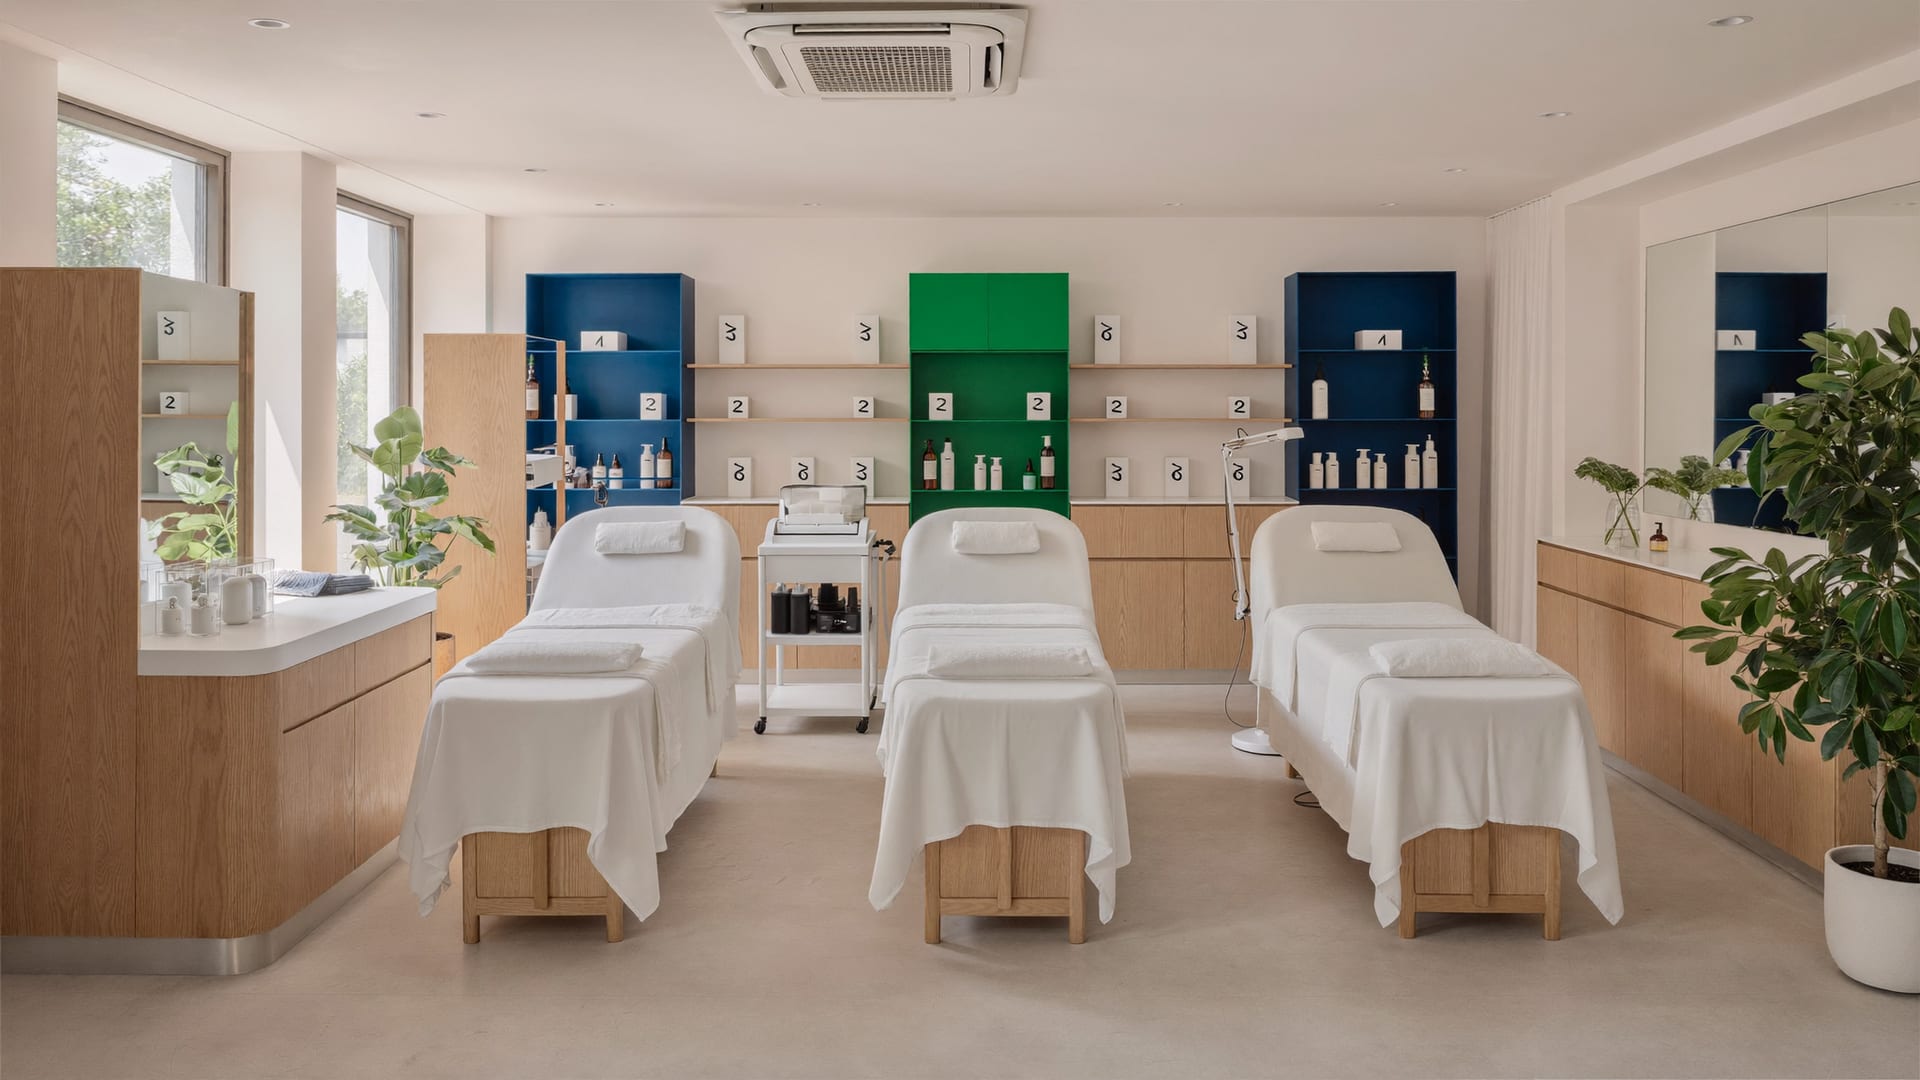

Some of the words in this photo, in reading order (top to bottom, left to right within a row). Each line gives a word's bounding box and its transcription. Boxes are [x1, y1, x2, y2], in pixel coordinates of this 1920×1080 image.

[165, 395, 176, 410] 2
[645, 397, 657, 411] 2
[732, 399, 744, 413] 2
[858, 399, 869, 413] 2
[936, 397, 948, 411] 2
[1033, 397, 1044, 411] 2
[1111, 399, 1123, 413] 2
[1234, 399, 1246, 413] 2
